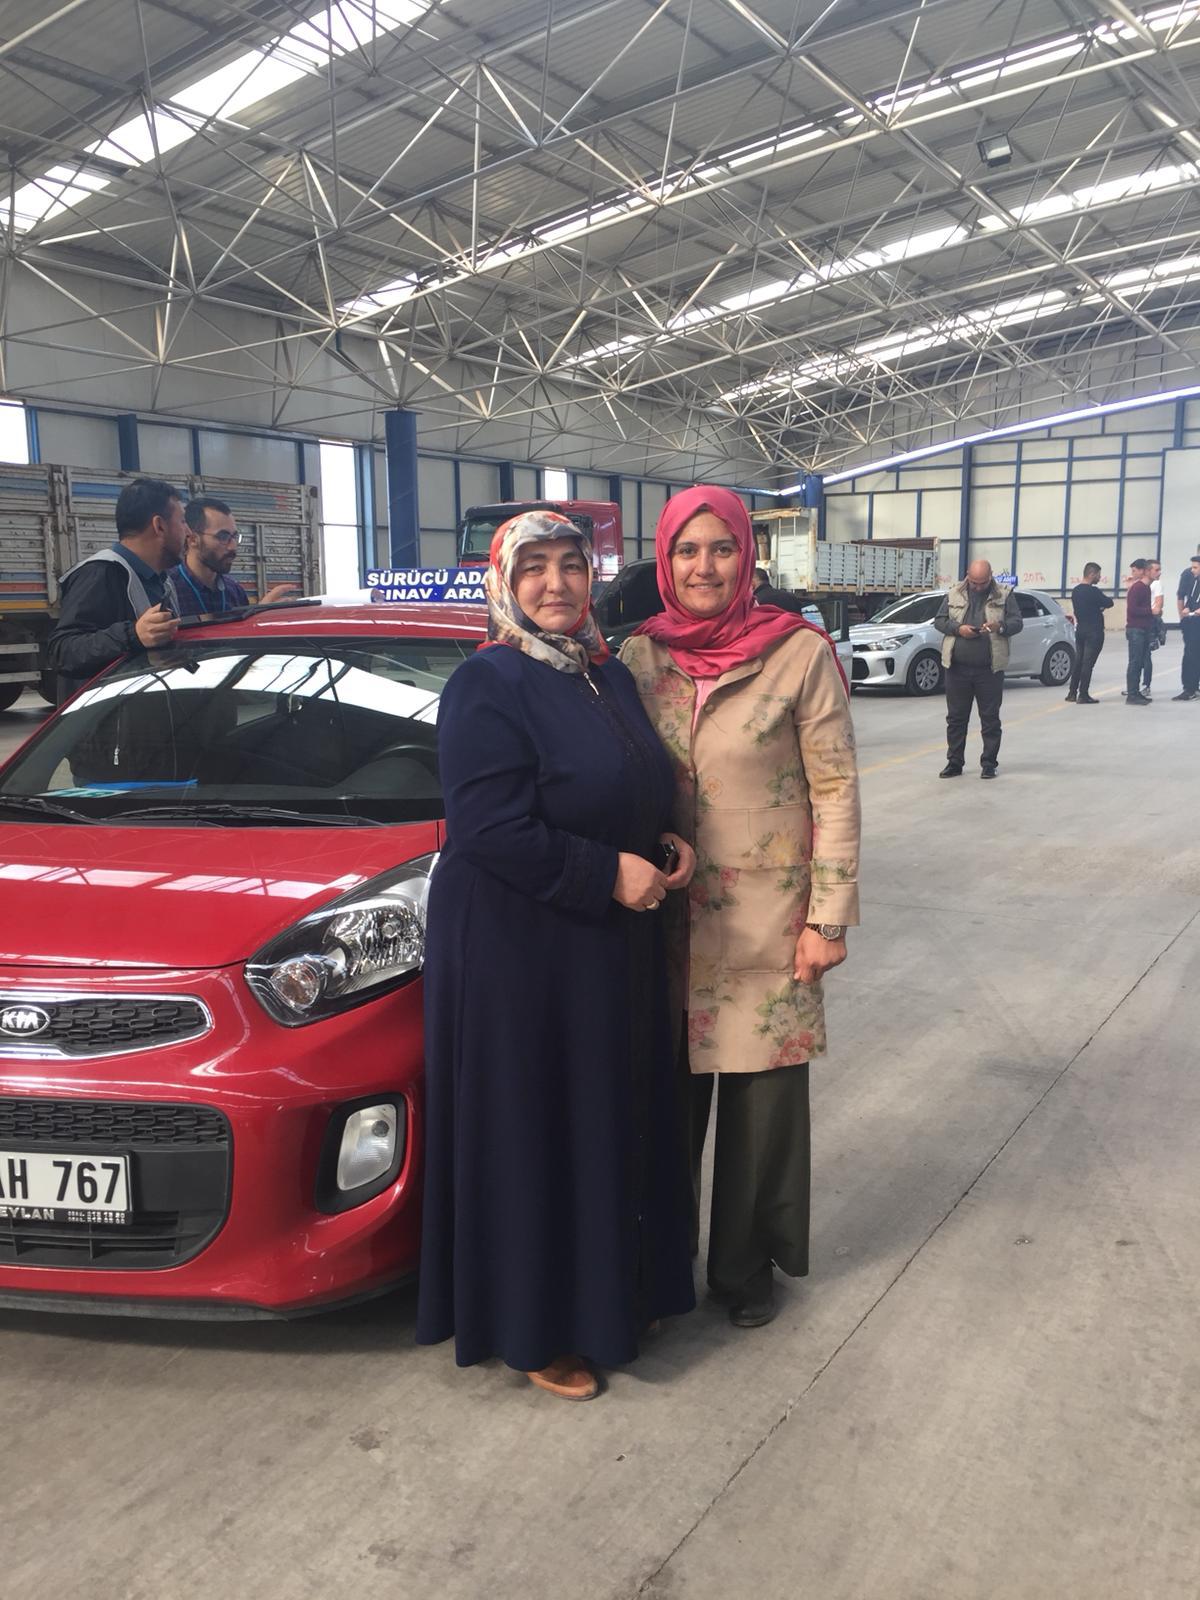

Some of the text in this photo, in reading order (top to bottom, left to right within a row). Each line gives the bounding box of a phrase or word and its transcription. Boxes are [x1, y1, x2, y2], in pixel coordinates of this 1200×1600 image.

[367, 569, 448, 586] SÜRÜCÜ
[379, 588, 485, 600] INAV ARA
[53, 1160, 121, 1204] 767
[0, 1206, 55, 1220] EYLAN
